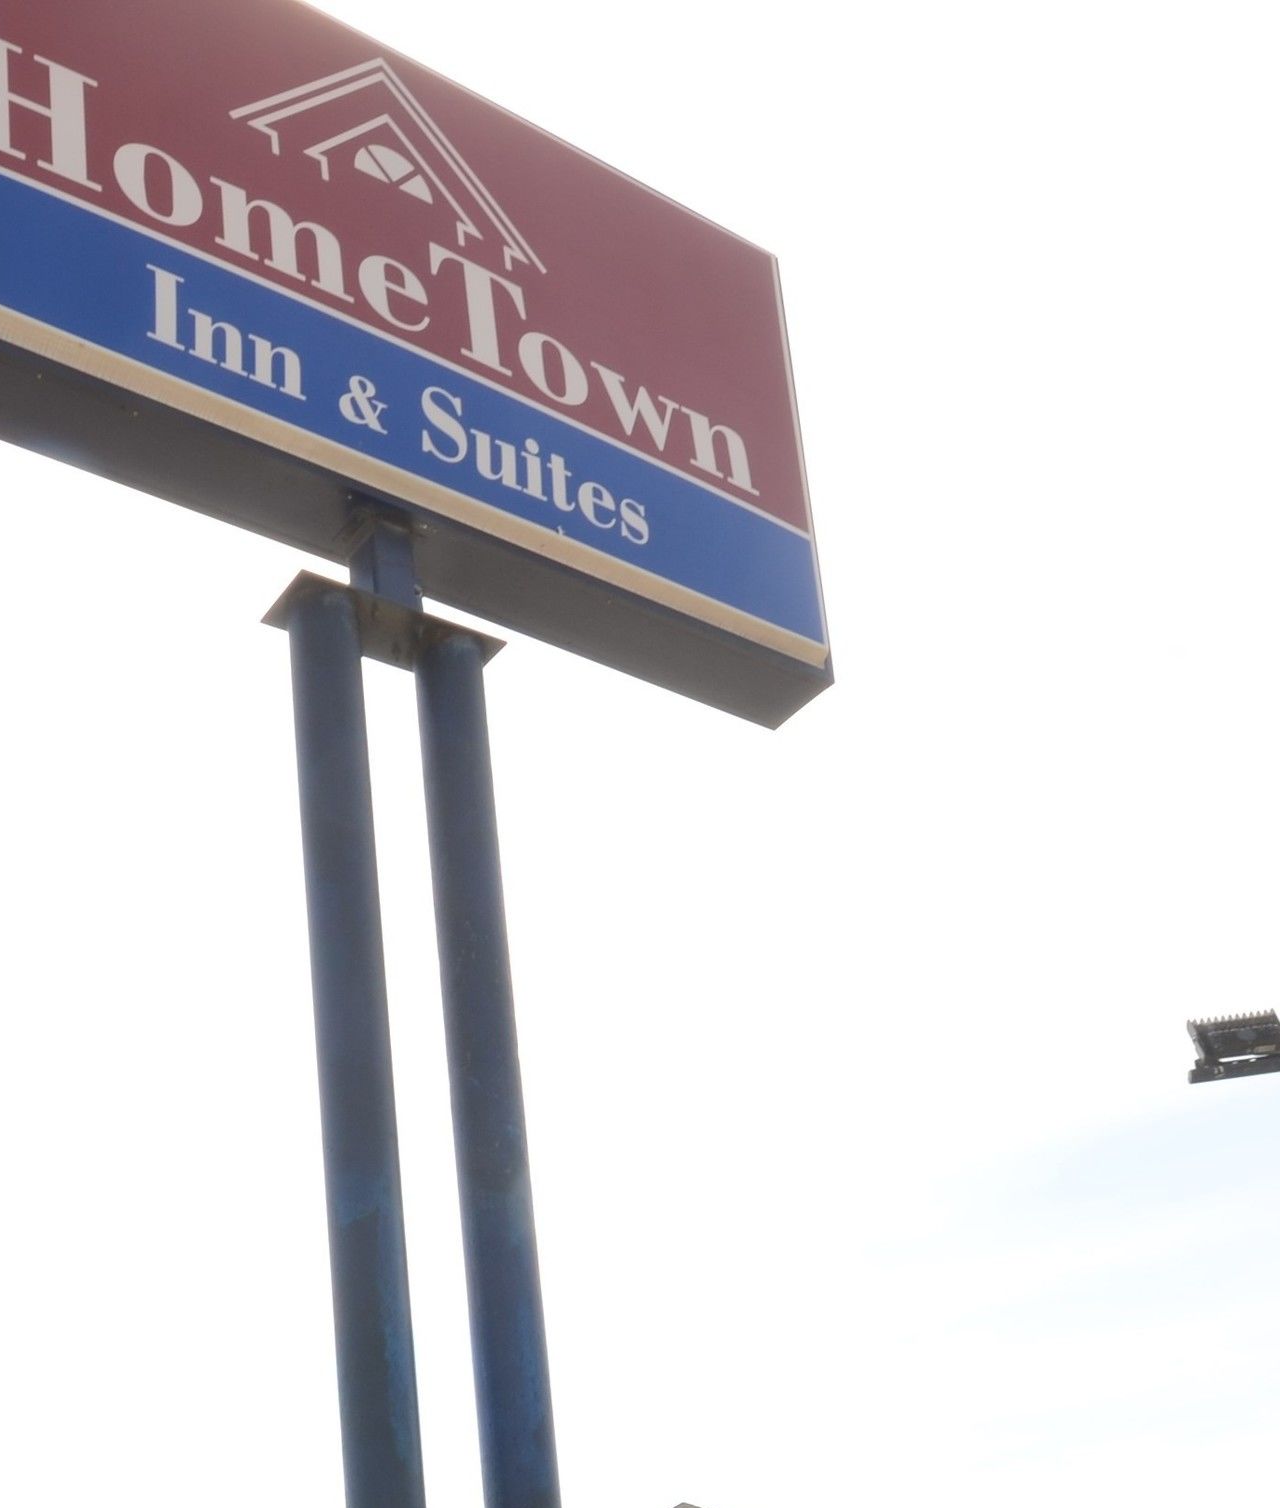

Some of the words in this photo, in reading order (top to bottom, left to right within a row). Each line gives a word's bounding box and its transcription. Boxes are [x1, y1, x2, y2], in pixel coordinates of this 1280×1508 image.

[146, 264, 306, 402] Inn
[338, 375, 388, 435] &
[420, 386, 650, 547] Suites
